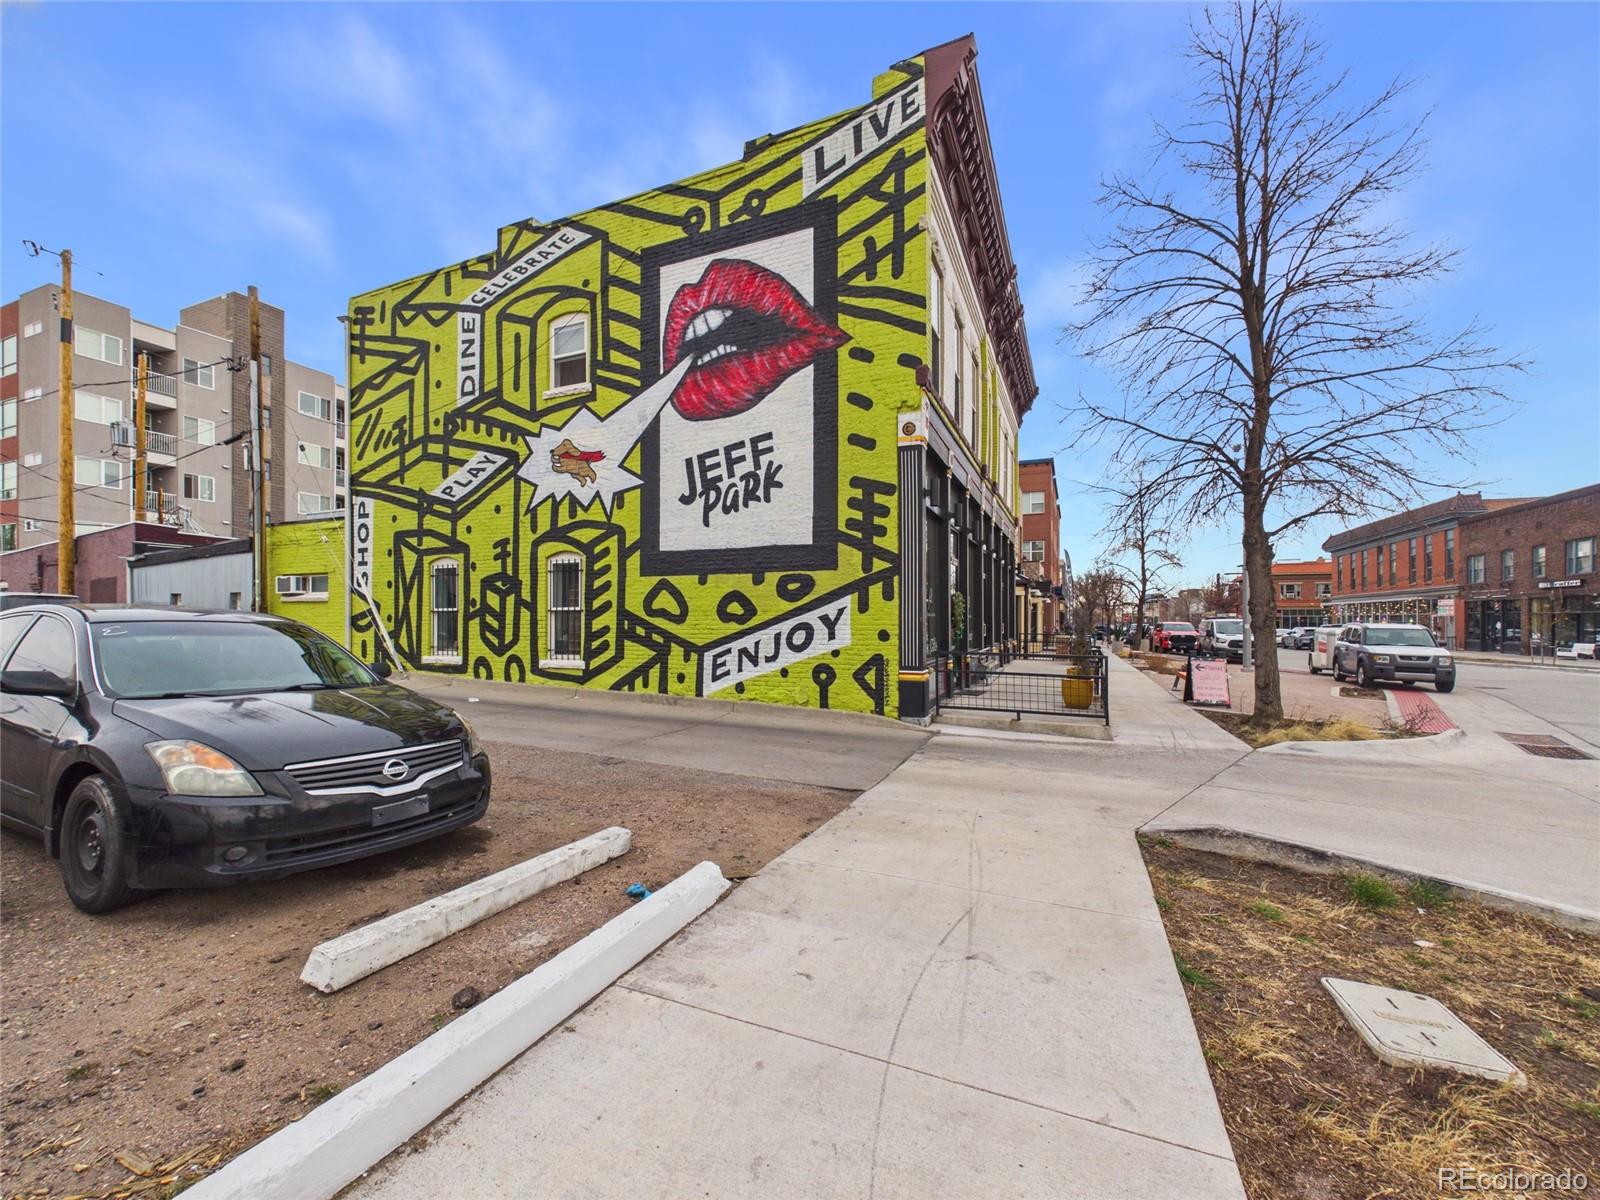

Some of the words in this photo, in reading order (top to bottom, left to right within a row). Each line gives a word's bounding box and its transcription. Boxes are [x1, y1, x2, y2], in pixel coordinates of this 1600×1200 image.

[815, 84, 920, 184] LIVE
[471, 233, 575, 305] CELEBRATE
[461, 317, 476, 399] DINE
[441, 455, 497, 498] PLAY
[678, 431, 774, 505] JEFF
[356, 501, 370, 588] SHOP
[711, 606, 848, 683] ENJOY
